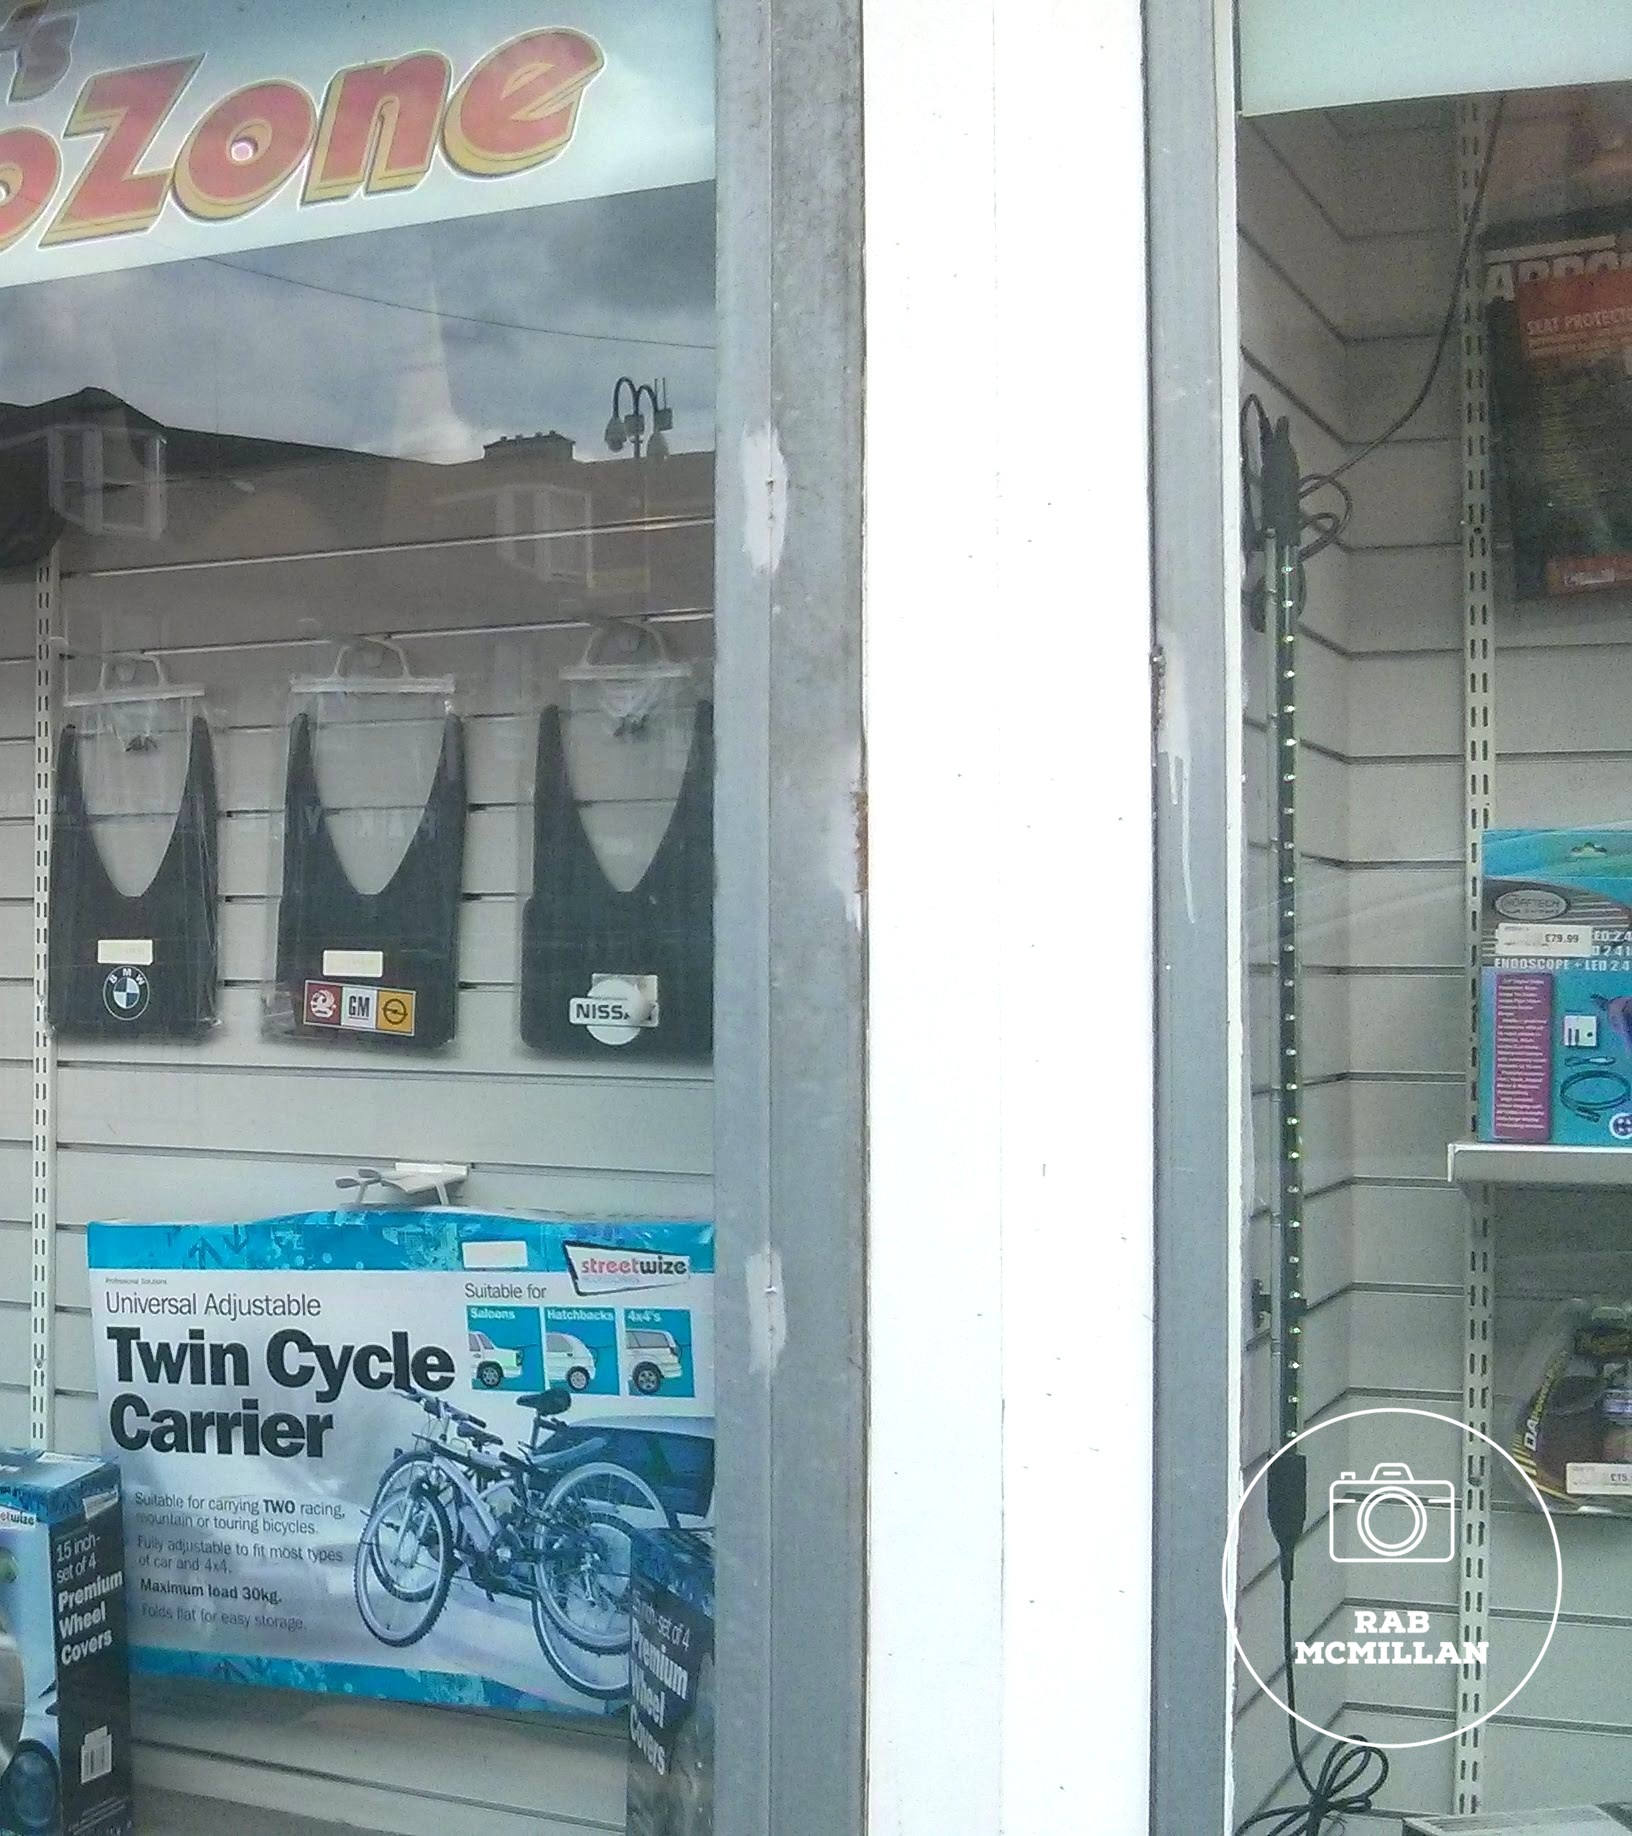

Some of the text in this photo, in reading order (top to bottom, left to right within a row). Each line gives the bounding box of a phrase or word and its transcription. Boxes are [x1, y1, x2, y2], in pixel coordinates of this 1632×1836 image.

[1545, 934, 1579, 944] £79.99
[1494, 957, 1568, 971] ENDOSCOPE
[1585, 958, 1607, 971] LED
[348, 996, 370, 1018] GM
[576, 1003, 655, 1021] NISS
[581, 1256, 687, 1275] streetwize
[464, 1282, 547, 1299] Suitable for
[106, 1291, 321, 1321] Universal Adjustable
[470, 1308, 516, 1320] Saloons
[547, 1308, 614, 1322] Hatchbacks
[106, 1327, 456, 1403] Twin Cycle
[110, 1393, 334, 1458] Carrier
[135, 1491, 346, 1519] Suitable for carrying TWO racing,
[197, 1517, 211, 1528] or
[214, 1517, 259, 1534] touring
[57, 1540, 72, 1562] 15
[138, 1535, 343, 1562] Fully adjustable to fit most types
[56, 1552, 96, 1583] set of 4
[138, 1555, 150, 1566] of
[153, 1558, 172, 1569] car
[176, 1556, 200, 1571] and
[58, 1570, 123, 1613] Premium
[140, 1578, 282, 1604] Maximum load 30kg.
[59, 1600, 106, 1639] Wheel
[176, 1606, 197, 1621] flat
[200, 1608, 217, 1622] for
[221, 1612, 251, 1628] easy
[254, 1613, 307, 1631] storage.
[61, 1630, 112, 1666] Covers
[631, 1616, 689, 1700] Premium
[630, 1658, 666, 1729] Wheel
[630, 1704, 666, 1776] Covers
